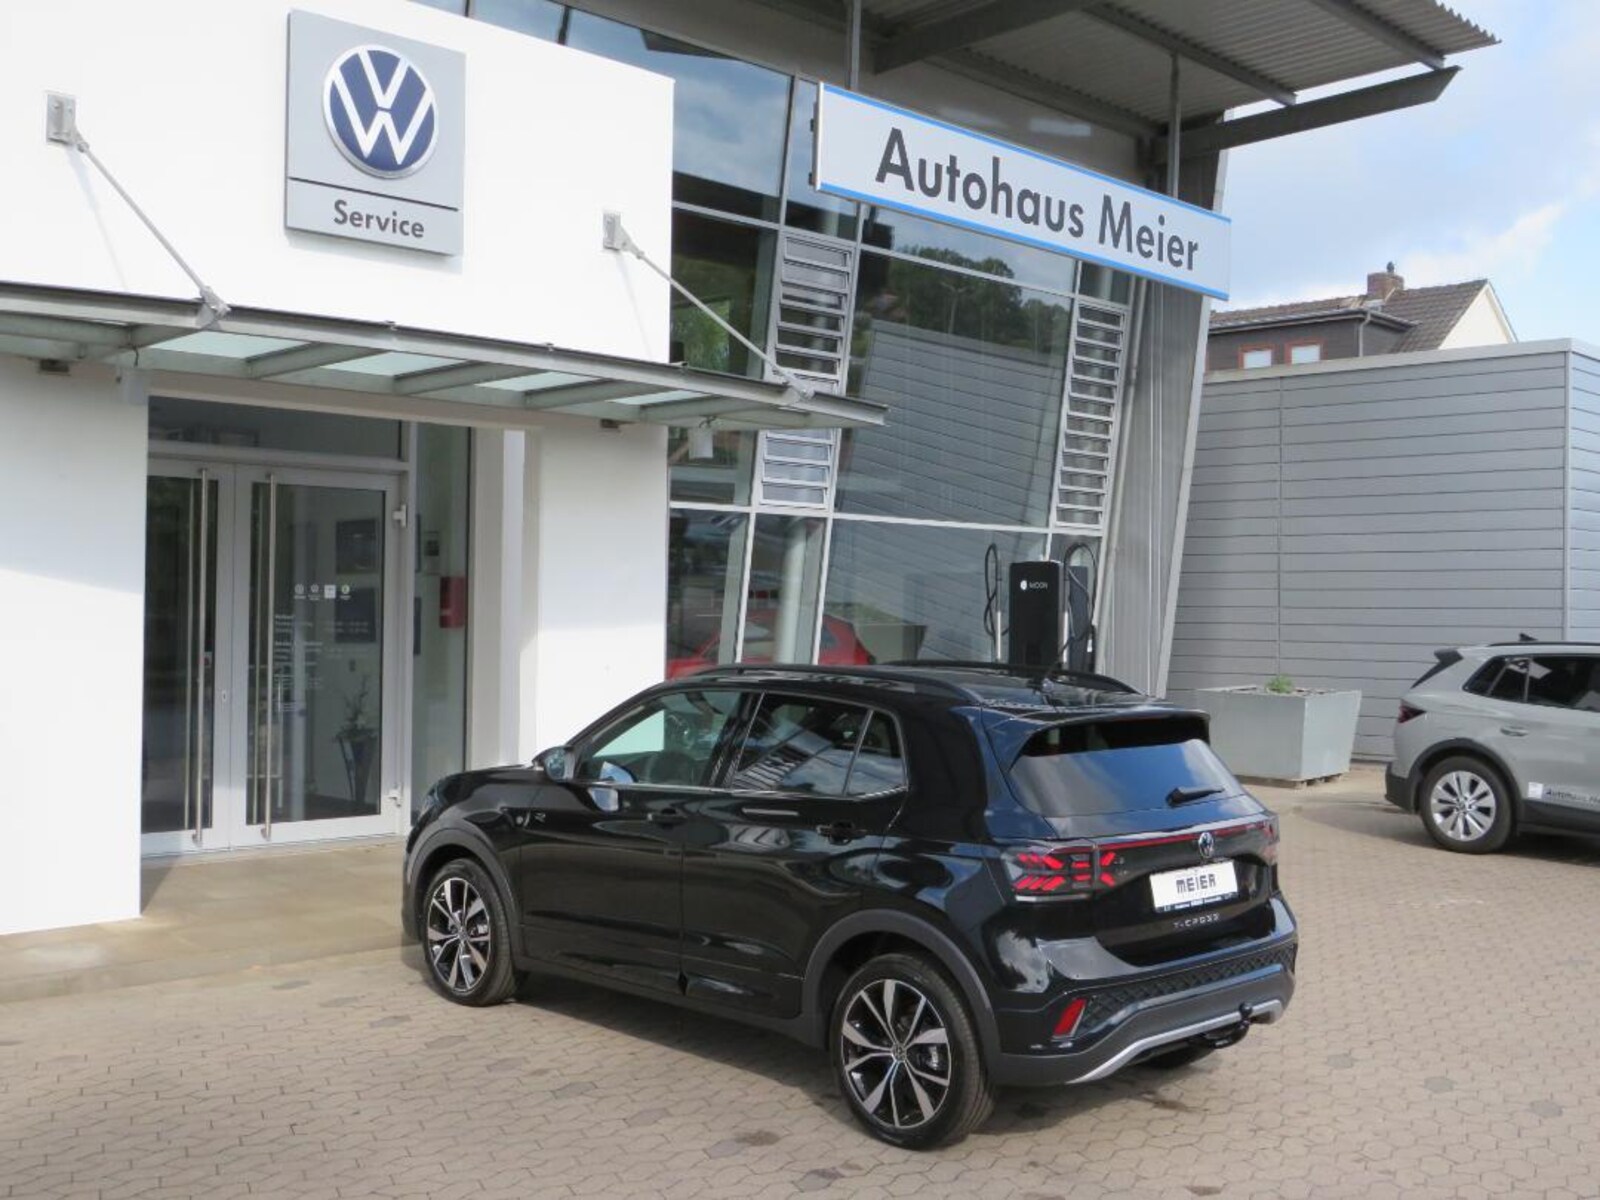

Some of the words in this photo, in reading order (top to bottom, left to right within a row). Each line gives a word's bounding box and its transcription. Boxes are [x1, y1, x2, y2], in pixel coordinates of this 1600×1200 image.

[327, 47, 437, 172] VW
[333, 199, 425, 238] Service
[875, 127, 1084, 238] Autohaus
[1098, 194, 1198, 272] Meier
[1176, 874, 1216, 893] MEIER
